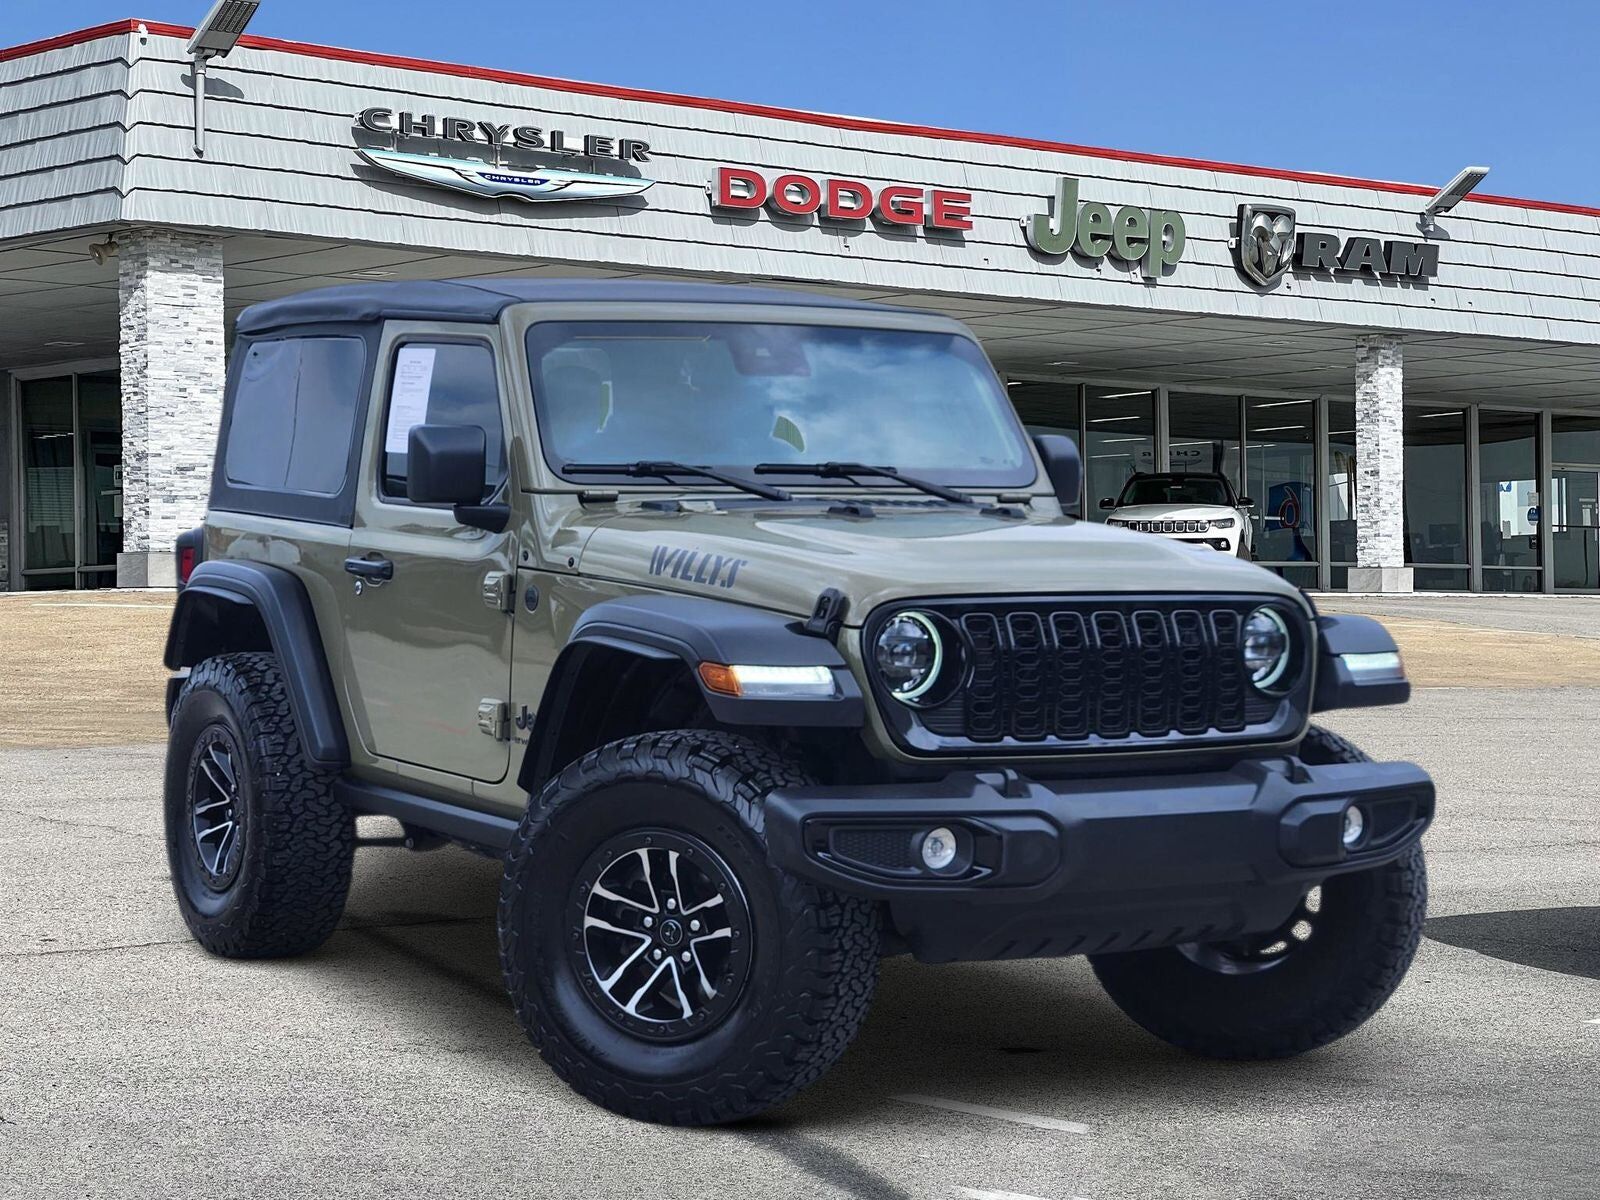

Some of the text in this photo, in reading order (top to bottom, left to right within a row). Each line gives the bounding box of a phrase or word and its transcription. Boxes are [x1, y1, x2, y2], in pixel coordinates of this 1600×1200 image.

[357, 107, 651, 162] CHRYSLER
[484, 174, 541, 185] CHRYSLER
[712, 166, 974, 231] DODGE
[1027, 177, 1187, 278] Jeep
[1295, 232, 1440, 277] RAM
[649, 545, 748, 588] WILLYS
[515, 704, 537, 731] Je
